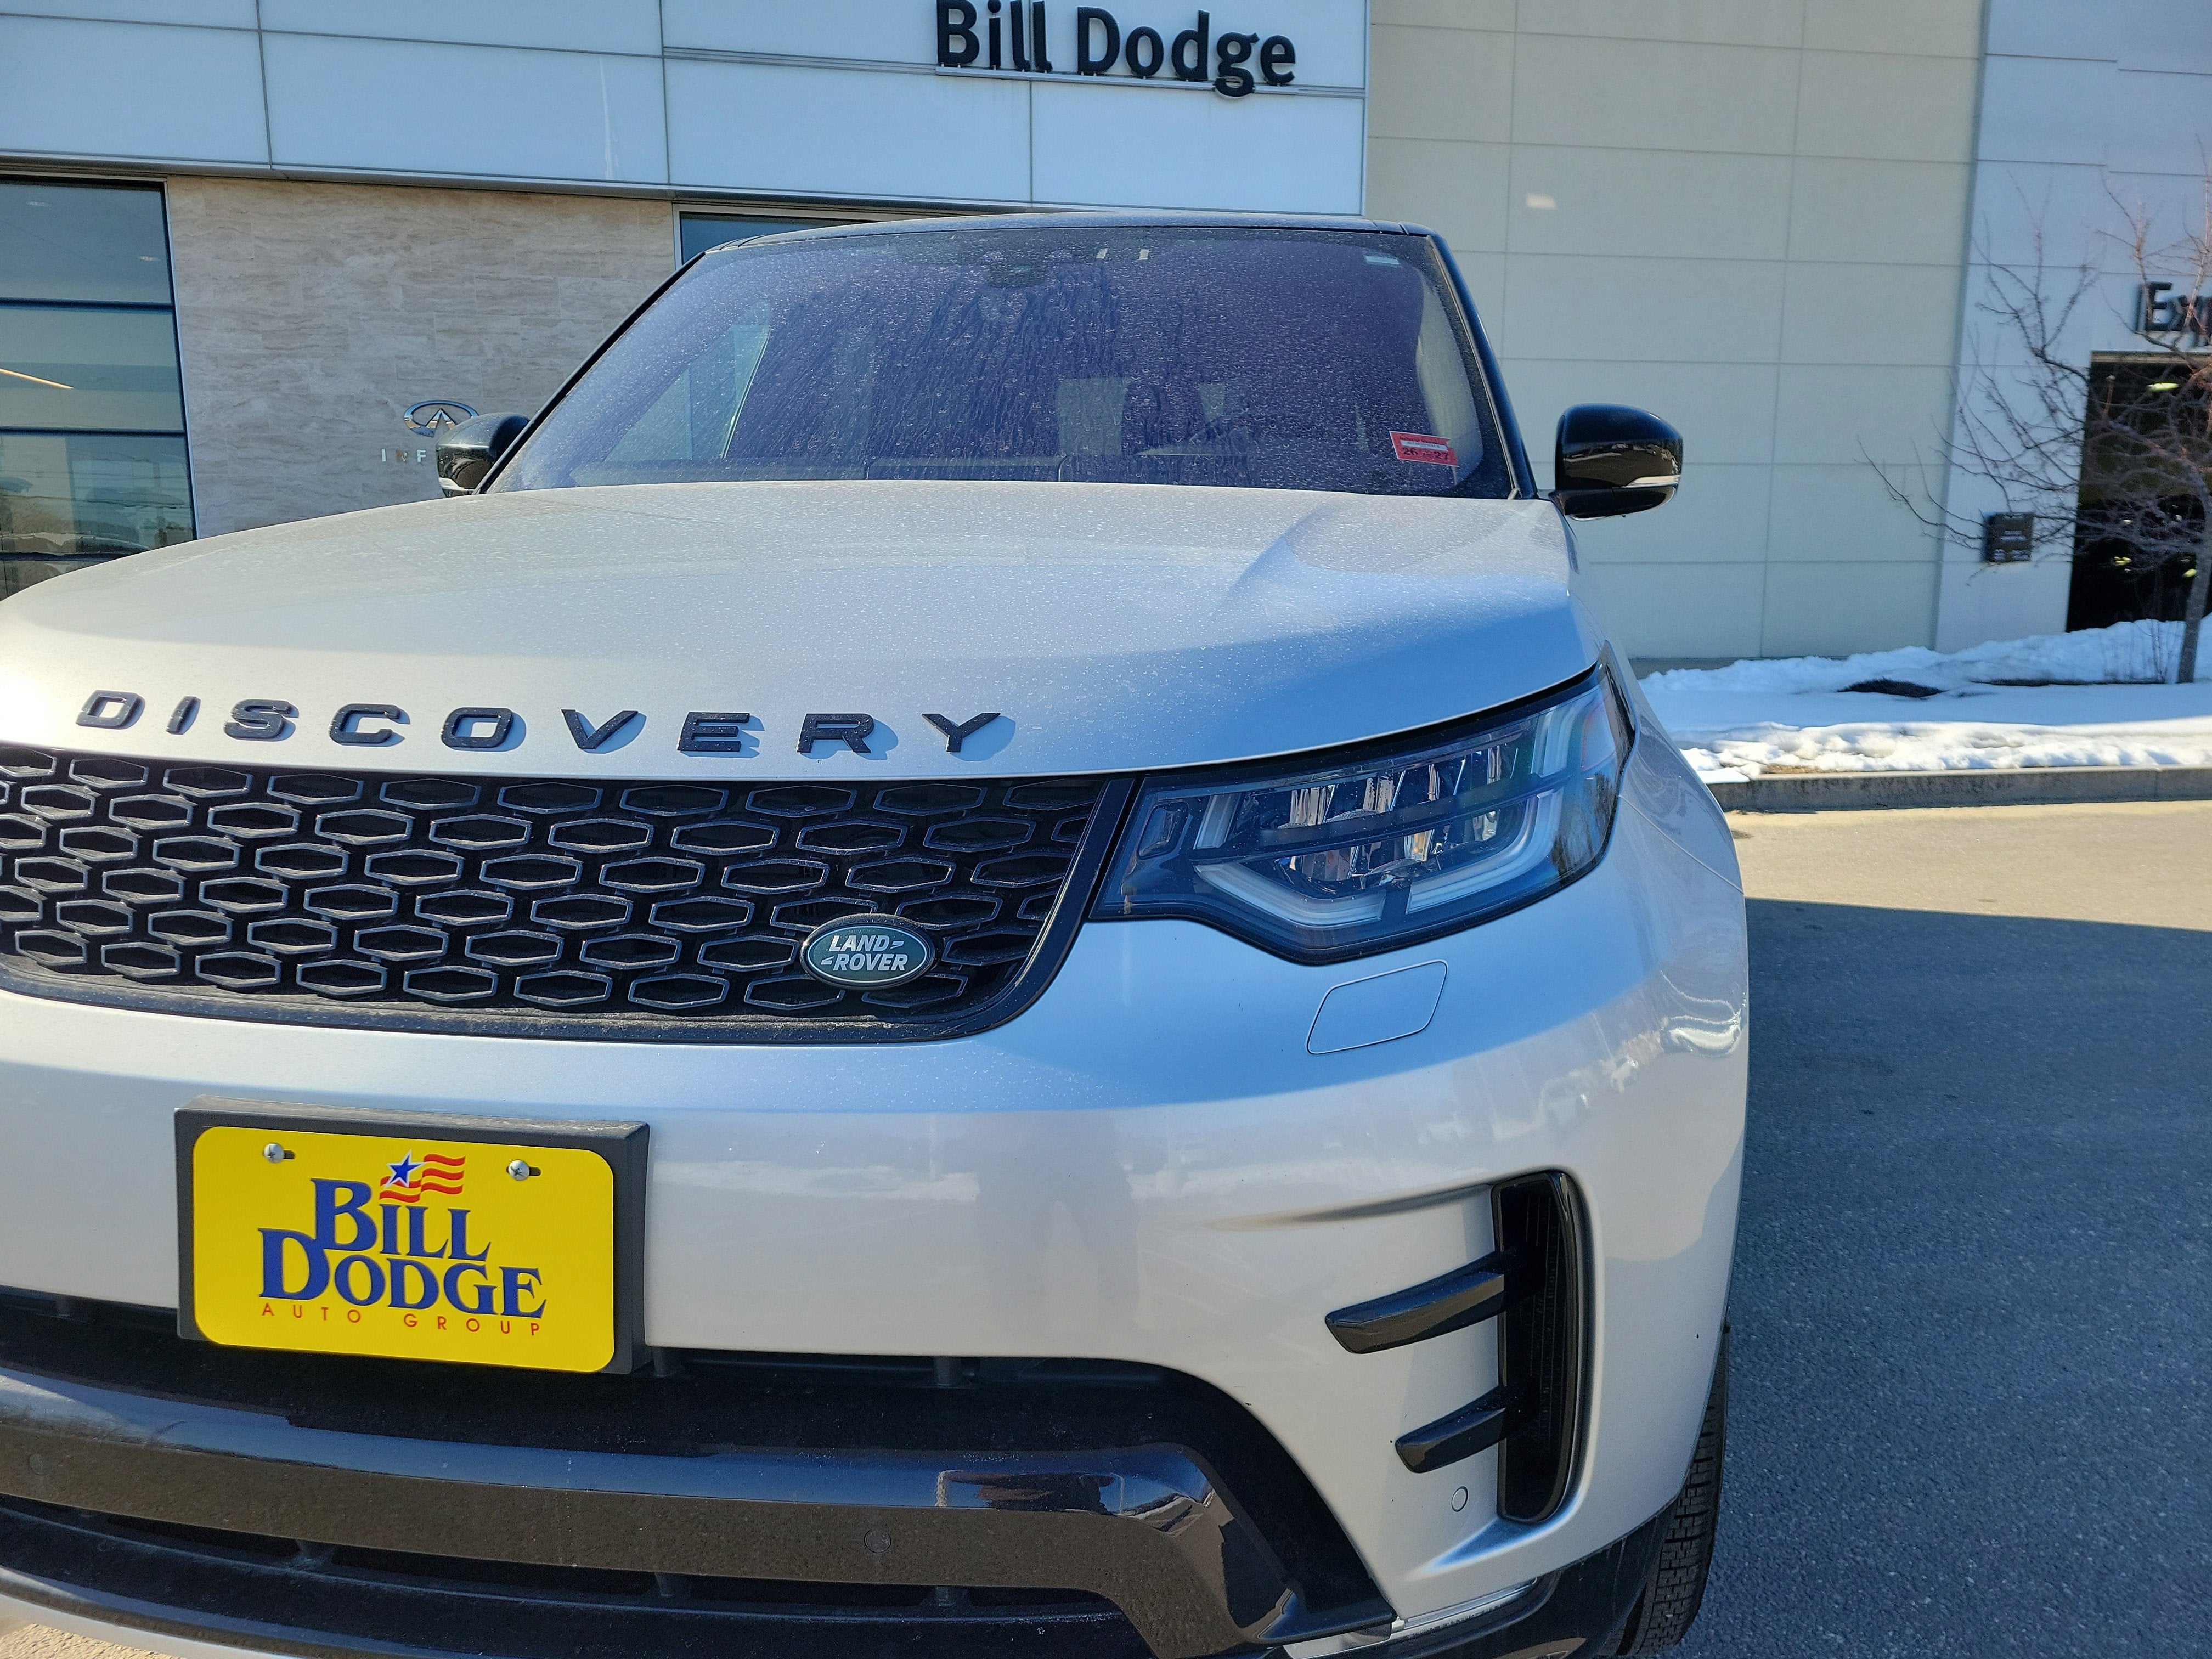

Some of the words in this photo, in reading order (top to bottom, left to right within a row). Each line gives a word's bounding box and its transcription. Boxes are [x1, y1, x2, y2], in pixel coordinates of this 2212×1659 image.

[936, 0, 1053, 73] Bill
[1077, 6, 1296, 97] Dodge
[75, 689, 1002, 753] DISCOVERY
[828, 934, 890, 952] LAND
[833, 952, 909, 971] ROVER
[310, 1177, 493, 1261] BILL
[258, 1227, 547, 1319] DODGE
[261, 1302, 362, 1324] AUTO
[403, 1312, 541, 1336] GROUP
